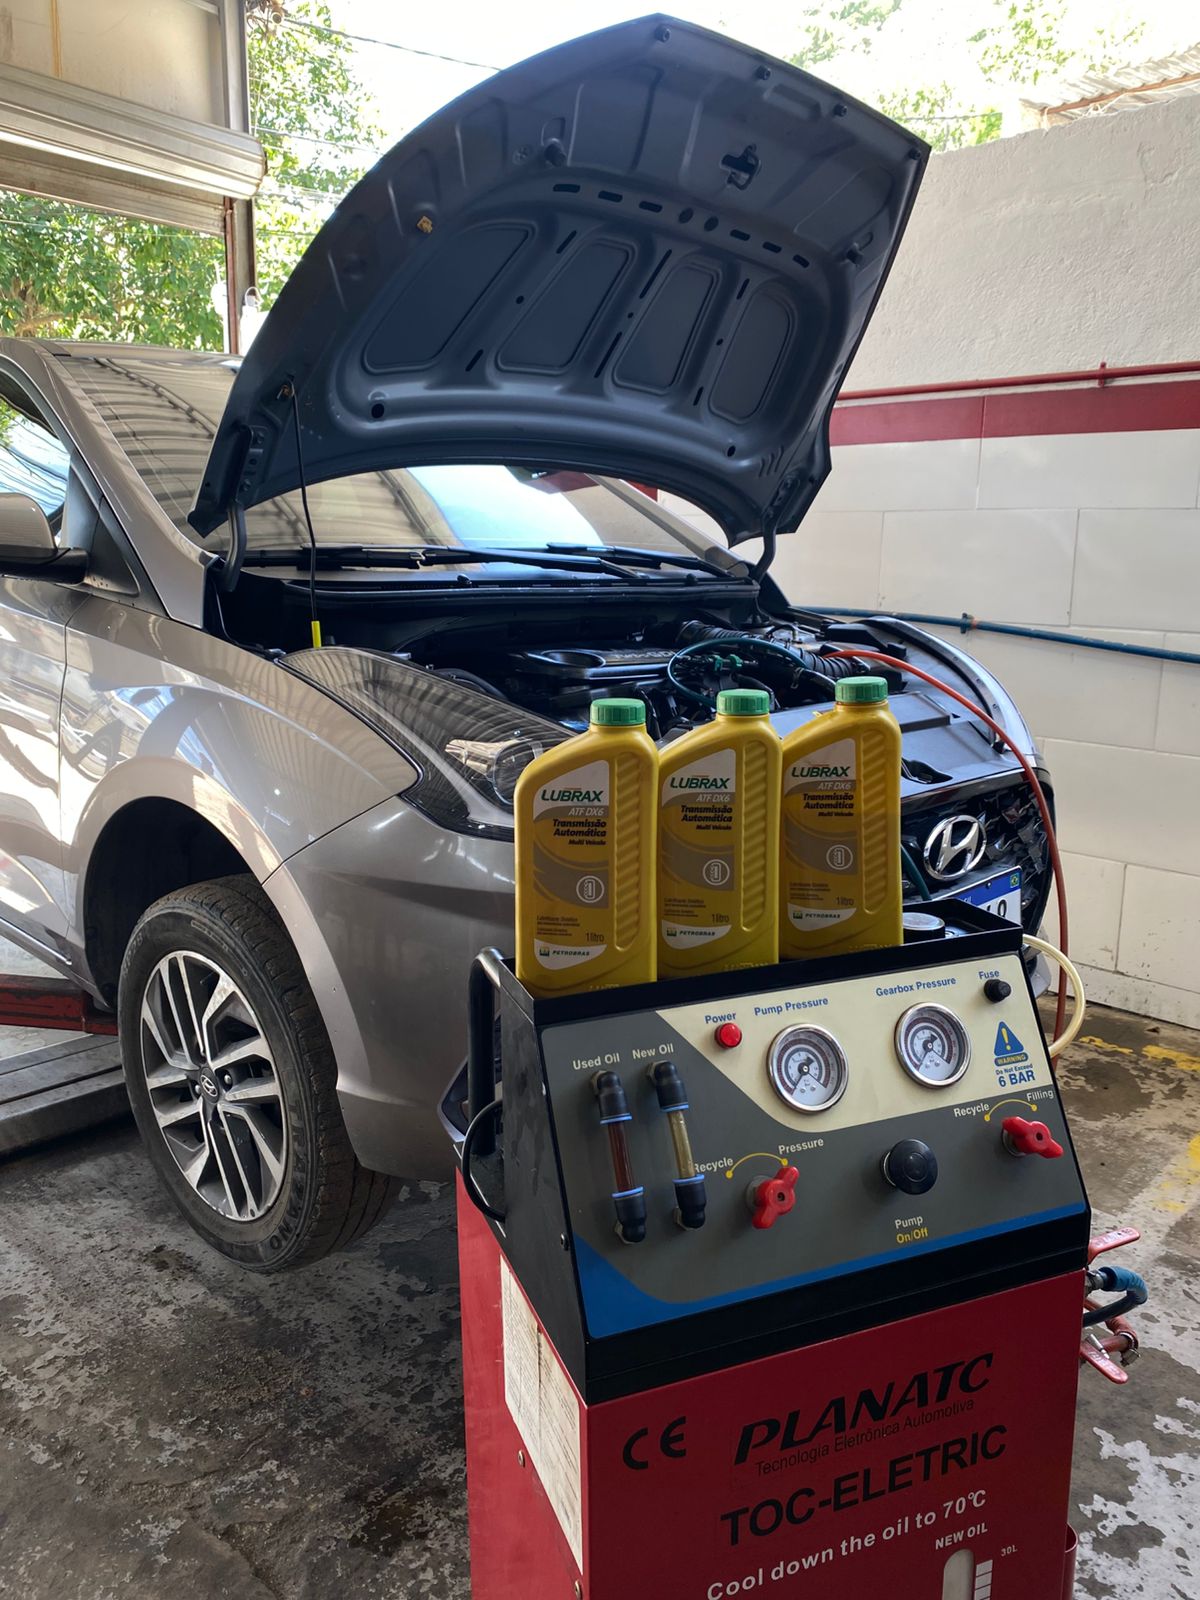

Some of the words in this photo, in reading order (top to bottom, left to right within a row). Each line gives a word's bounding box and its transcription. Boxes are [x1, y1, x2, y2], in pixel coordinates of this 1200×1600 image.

[791, 766, 850, 777] LUBRAX
[670, 777, 730, 789] LUBRAX
[818, 782, 834, 790] ATF
[834, 782, 851, 790] DX6
[541, 789, 604, 802] LUBRAX
[696, 793, 711, 802] ATF
[712, 793, 730, 802] DX6
[803, 792, 854, 801] Transmissão
[681, 805, 733, 813] Transmissão
[803, 801, 854, 809] Automática
[568, 807, 584, 816] ATF
[585, 807, 604, 816] DX6
[681, 813, 733, 822] Automática
[552, 818, 606, 828] Transmissão
[553, 828, 606, 837] Automática
[979, 969, 1000, 979] Fuse
[876, 984, 914, 997] Gearbox
[916, 977, 957, 990] Pressure
[754, 1004, 783, 1016] Pump
[785, 997, 829, 1011] Pressure
[705, 1012, 737, 1024] Power
[632, 1048, 656, 1060] New
[659, 1043, 674, 1055] Oil
[573, 1056, 602, 1070] Used
[604, 1052, 620, 1064] Oil
[998, 1054, 1025, 1065] WARNING
[1014, 1063, 1033, 1072] Exceed
[998, 1076, 1007, 1087] 6
[1009, 1070, 1036, 1085] BAR
[1026, 1090, 1054, 1101] Filling
[953, 1103, 990, 1118] Recycle
[778, 1137, 824, 1155] Pressure
[694, 1157, 733, 1173] Recycle
[894, 1215, 923, 1230] Pump
[896, 1227, 929, 1244] On/Off
[734, 1352, 994, 1466] PLANATC
[622, 1415, 687, 1470] CE
[755, 1446, 830, 1477] Tecnologia
[834, 1420, 900, 1452] Eletrônica
[902, 1398, 975, 1431] Automotiva
[720, 1424, 1007, 1546] TOC-ELETRIC
[935, 1531, 964, 1550] NEW
[967, 1522, 988, 1538] OIL
[707, 1568, 763, 1600] Cool
[771, 1547, 833, 1581] down
[840, 1533, 875, 1556] the
[882, 1516, 909, 1540] oil
[915, 1511, 936, 1529] to
[1001, 1545, 1018, 1557] 30L
